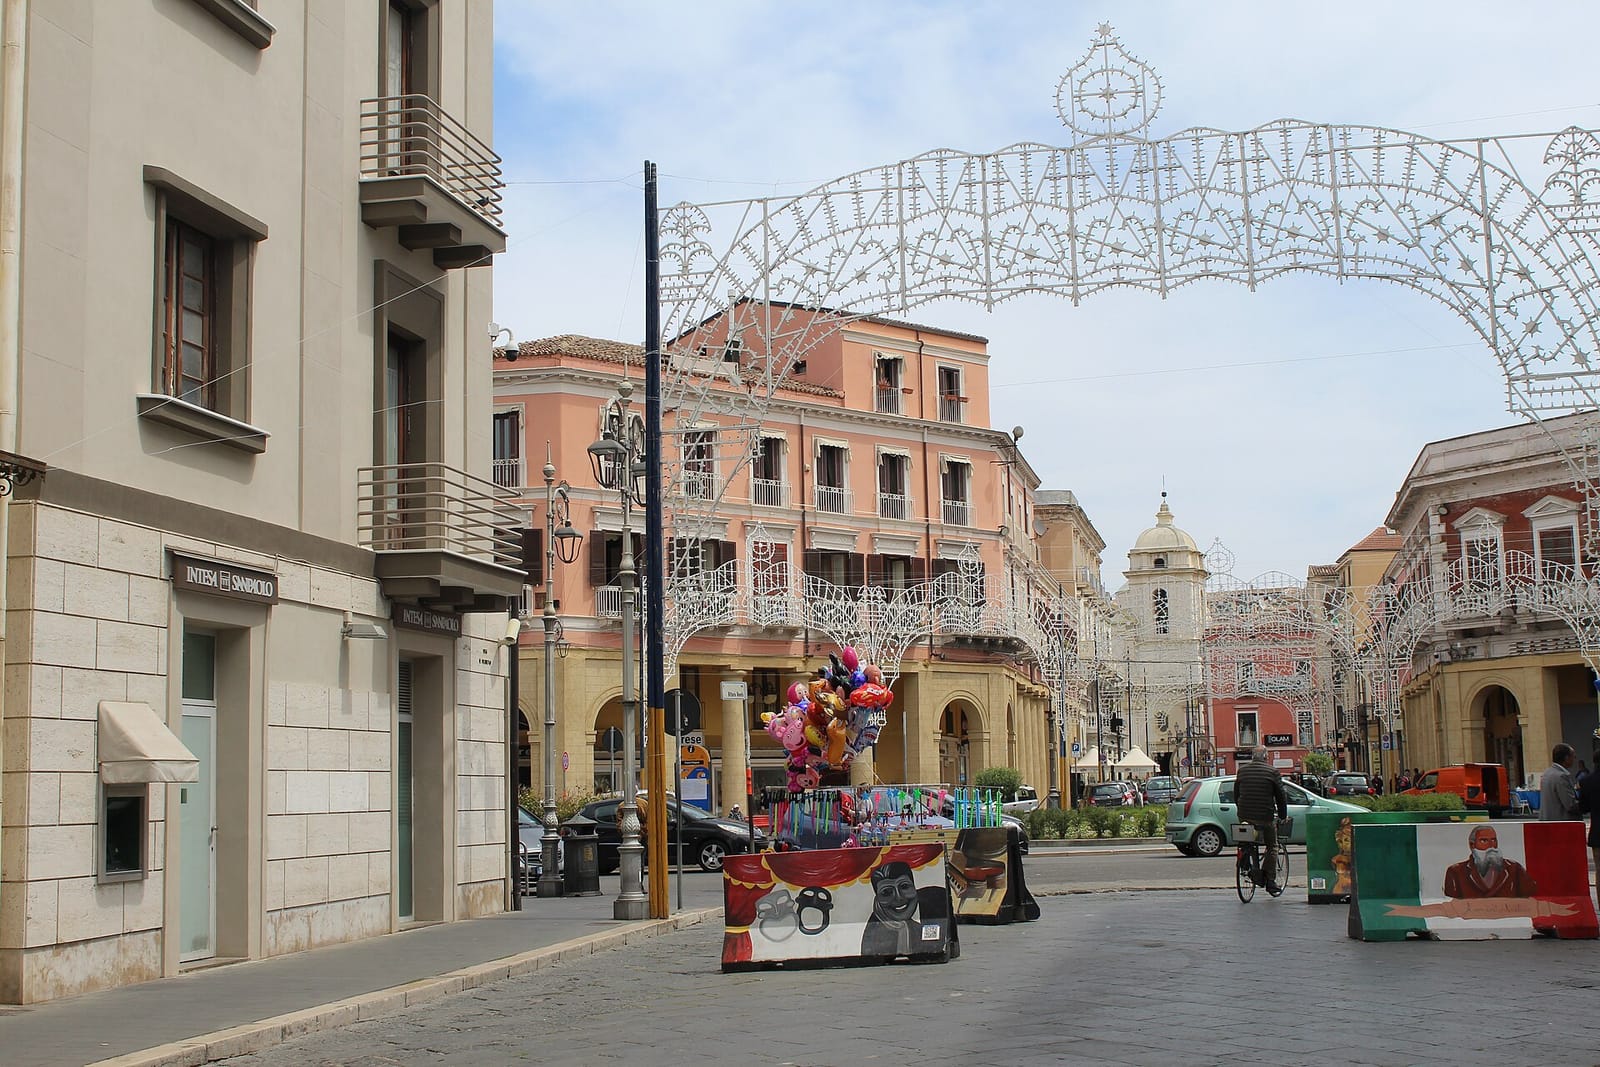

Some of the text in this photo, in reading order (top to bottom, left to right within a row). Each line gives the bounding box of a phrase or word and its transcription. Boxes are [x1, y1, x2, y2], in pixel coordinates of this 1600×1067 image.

[187, 566, 273, 596] INTESA SANPAOLO
[403, 609, 459, 632] INTESA SANPAOLO
